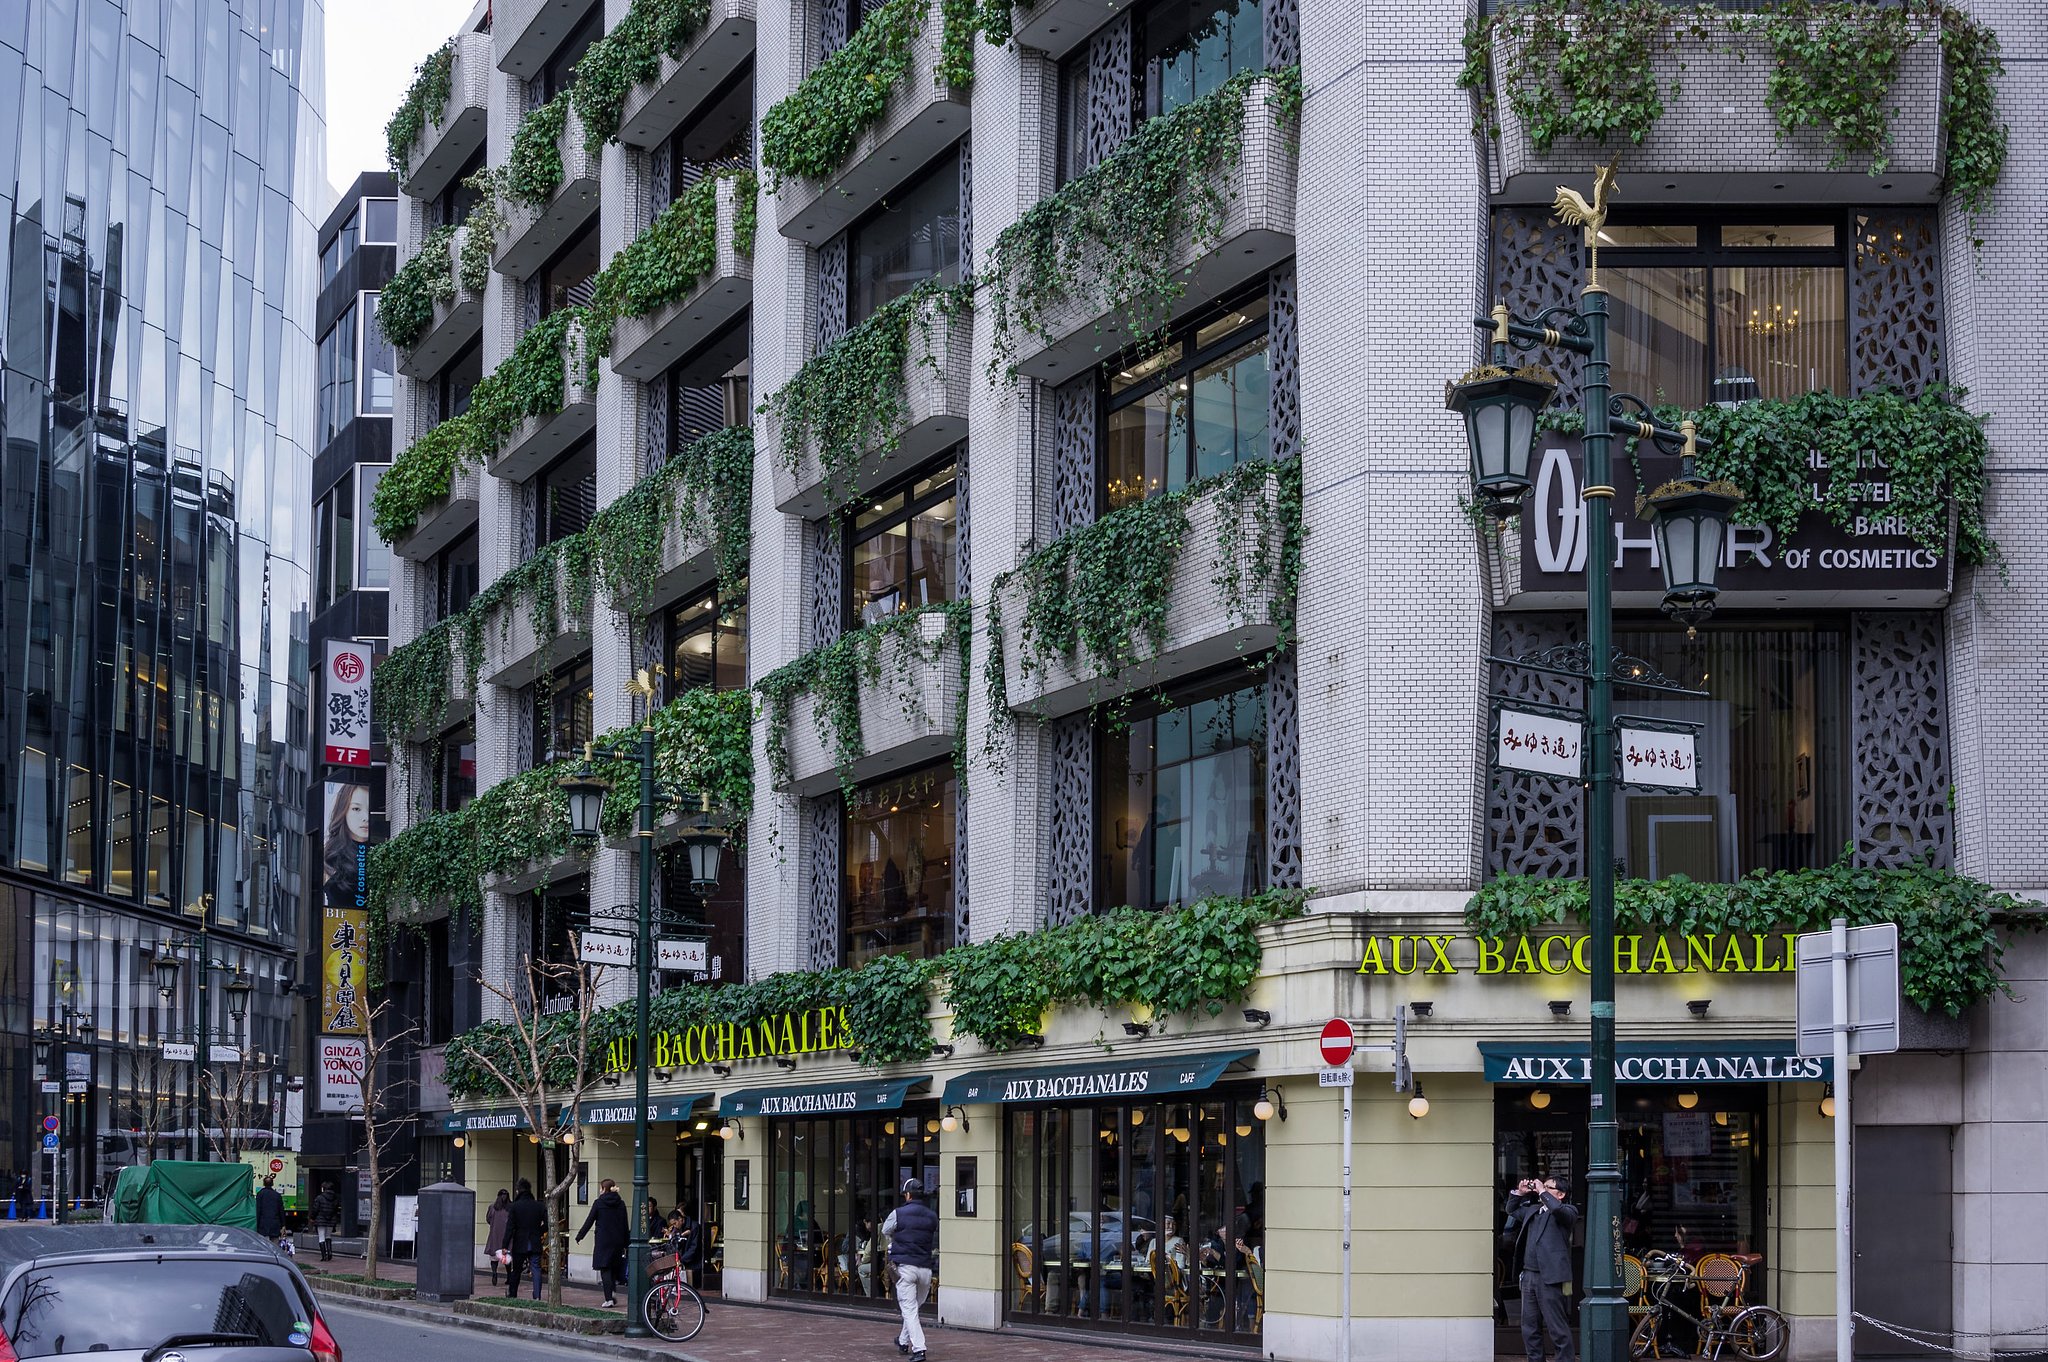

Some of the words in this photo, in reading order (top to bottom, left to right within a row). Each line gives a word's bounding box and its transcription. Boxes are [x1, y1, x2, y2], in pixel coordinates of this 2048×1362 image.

[1785, 548, 1811, 569] Of
[1819, 548, 1938, 569] COSMETICS
[336, 748, 358, 762] 7F
[1503, 728, 1578, 759] みゆき通り
[1626, 745, 1692, 771] みゆき通り
[356, 845, 366, 892] cosmetics
[1354, 935, 1459, 975] AUX
[330, 920, 359, 1031] 東方見聞録
[324, 1046, 362, 1057] GINZA
[605, 1033, 638, 1074] AU
[327, 1074, 358, 1085] HALL
[1320, 1071, 1352, 1084] 自転車を除く
[1503, 1057, 1574, 1080] AUX
[967, 1087, 979, 1098] BAR
[1002, 1079, 1034, 1100] AUX
[1035, 1071, 1149, 1098] BACCHANALES
[1179, 1072, 1196, 1084] CAFE
[759, 1097, 781, 1114] AUX
[781, 1092, 857, 1113] BACCHANALES
[588, 1108, 605, 1123] AUX
[1612, 1215, 1623, 1278] みゆき通り
